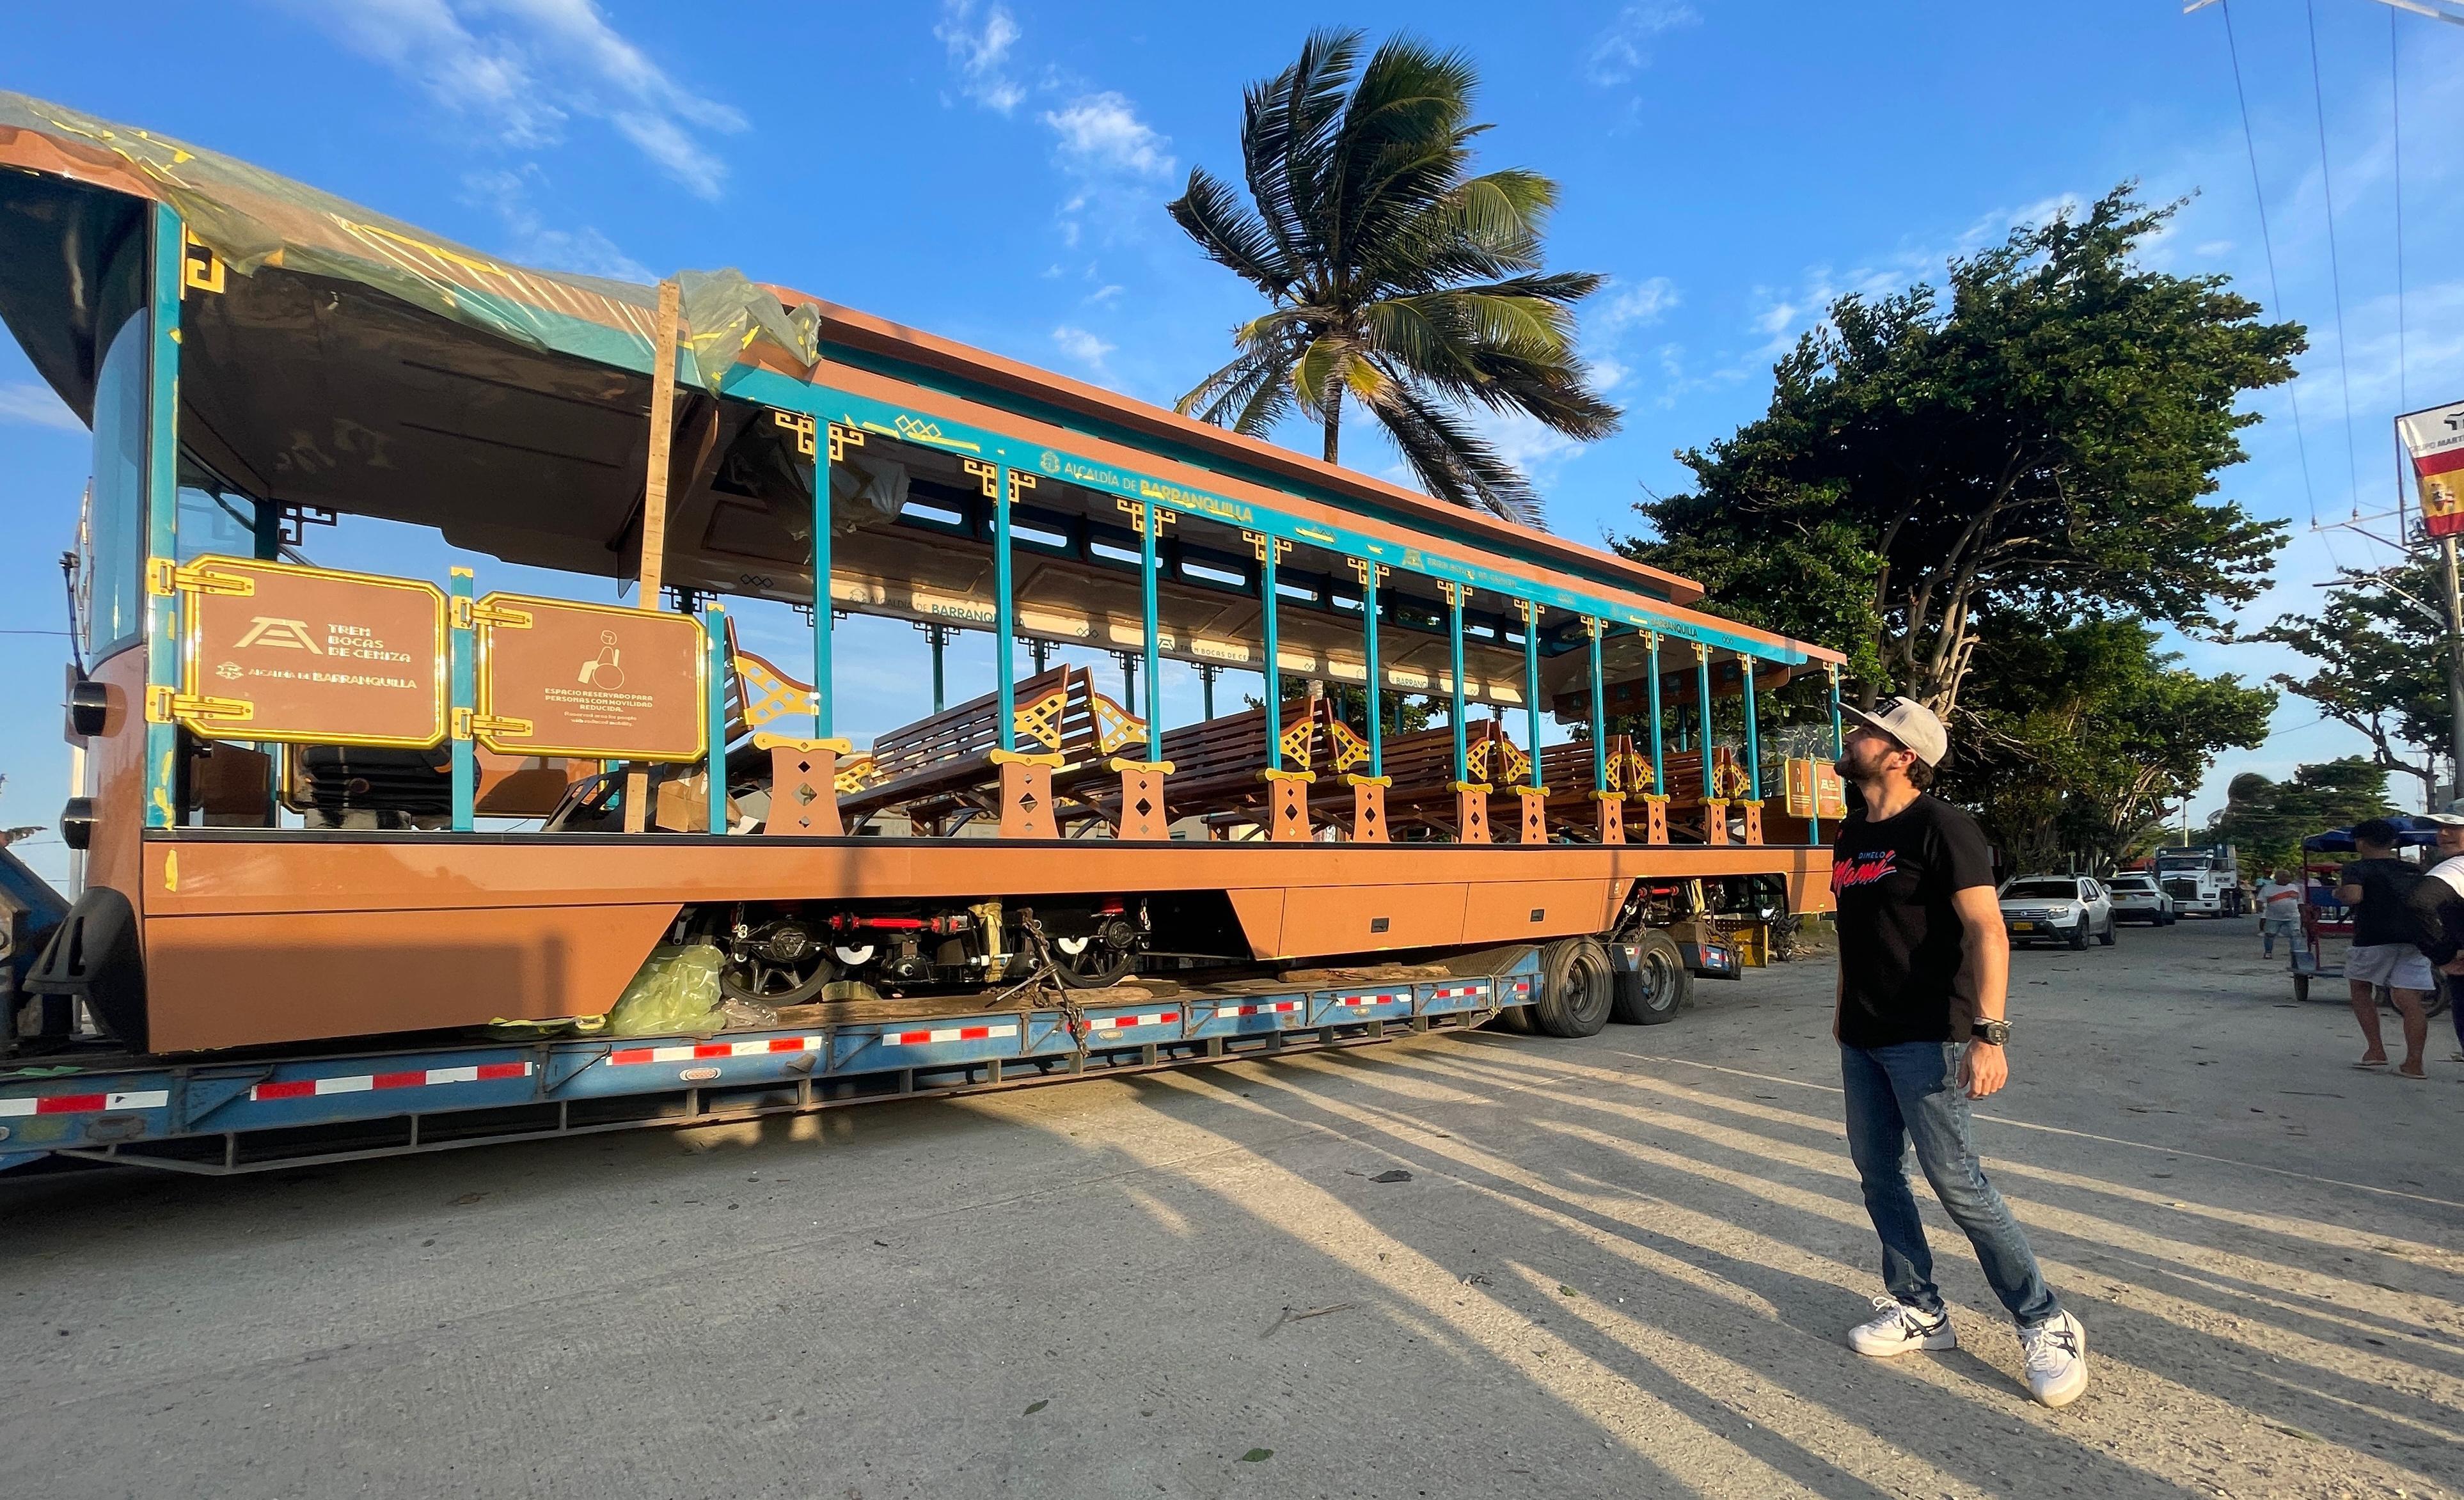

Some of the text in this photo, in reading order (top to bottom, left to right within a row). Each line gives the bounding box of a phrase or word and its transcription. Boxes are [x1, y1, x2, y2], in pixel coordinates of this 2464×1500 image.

[1123, 477, 1137, 491] DE
[1140, 479, 1253, 523] BARRANQUILLA
[916, 603, 928, 612] DE
[328, 635, 384, 649] BOCAS
[328, 646, 411, 663] DE CENIZA
[1201, 648, 1226, 658] BOCAS
[312, 672, 418, 689] BARRANQUILLA
[544, 688, 581, 696] ESPACIO
[582, 691, 631, 700] RESERVADO
[545, 695, 590, 704] PERSONAS
[609, 699, 653, 707] MOVILIDAD
[580, 704, 624, 713] REDUCIDA.
[1858, 851, 1886, 860] DIMELO
